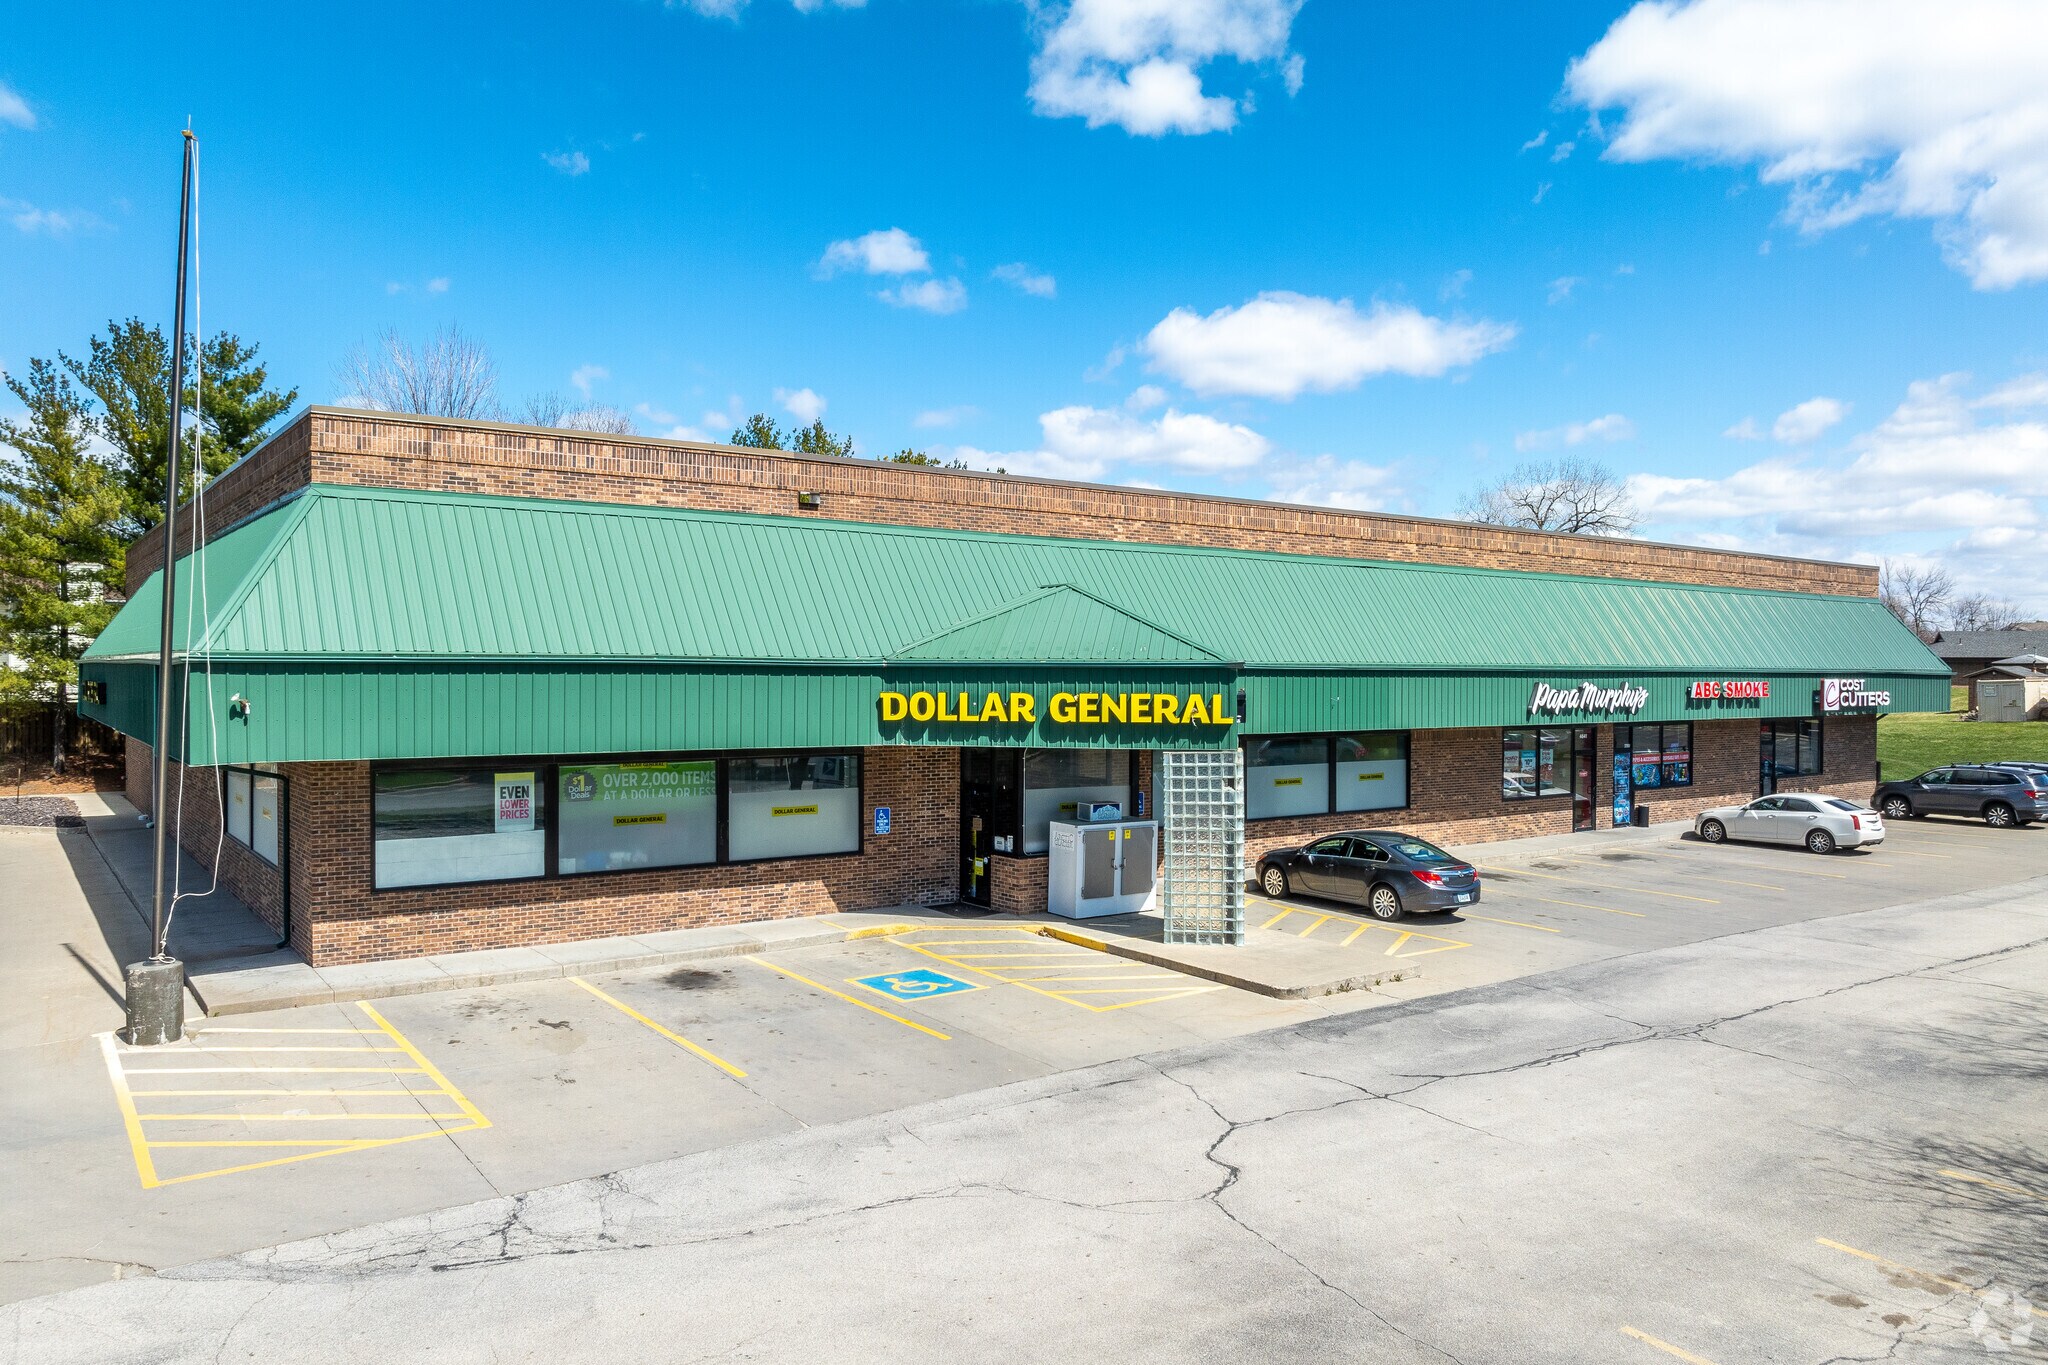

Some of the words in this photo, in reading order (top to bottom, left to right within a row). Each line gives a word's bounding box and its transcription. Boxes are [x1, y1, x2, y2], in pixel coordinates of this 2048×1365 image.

[1694, 681, 1720, 698] ABC
[1725, 681, 1769, 698] SMOKE
[1840, 679, 1865, 691] COST
[1531, 682, 1580, 715] Papa
[1580, 681, 1649, 715] Murphy's
[1840, 691, 1890, 707] CUTTERS
[880, 691, 1036, 722] DOLLAR
[1049, 693, 1234, 725] GENERAL
[603, 772, 638, 788] OVER
[641, 772, 679, 788] 2,000
[682, 768, 716, 785] ITEMS
[500, 785, 530, 799] EVEN
[603, 791, 617, 801] AT
[620, 790, 628, 800] A
[631, 789, 672, 800] DOLLAR
[675, 788, 691, 798] OR
[500, 799, 530, 809] LOWER
[500, 809, 530, 820] PRICES
